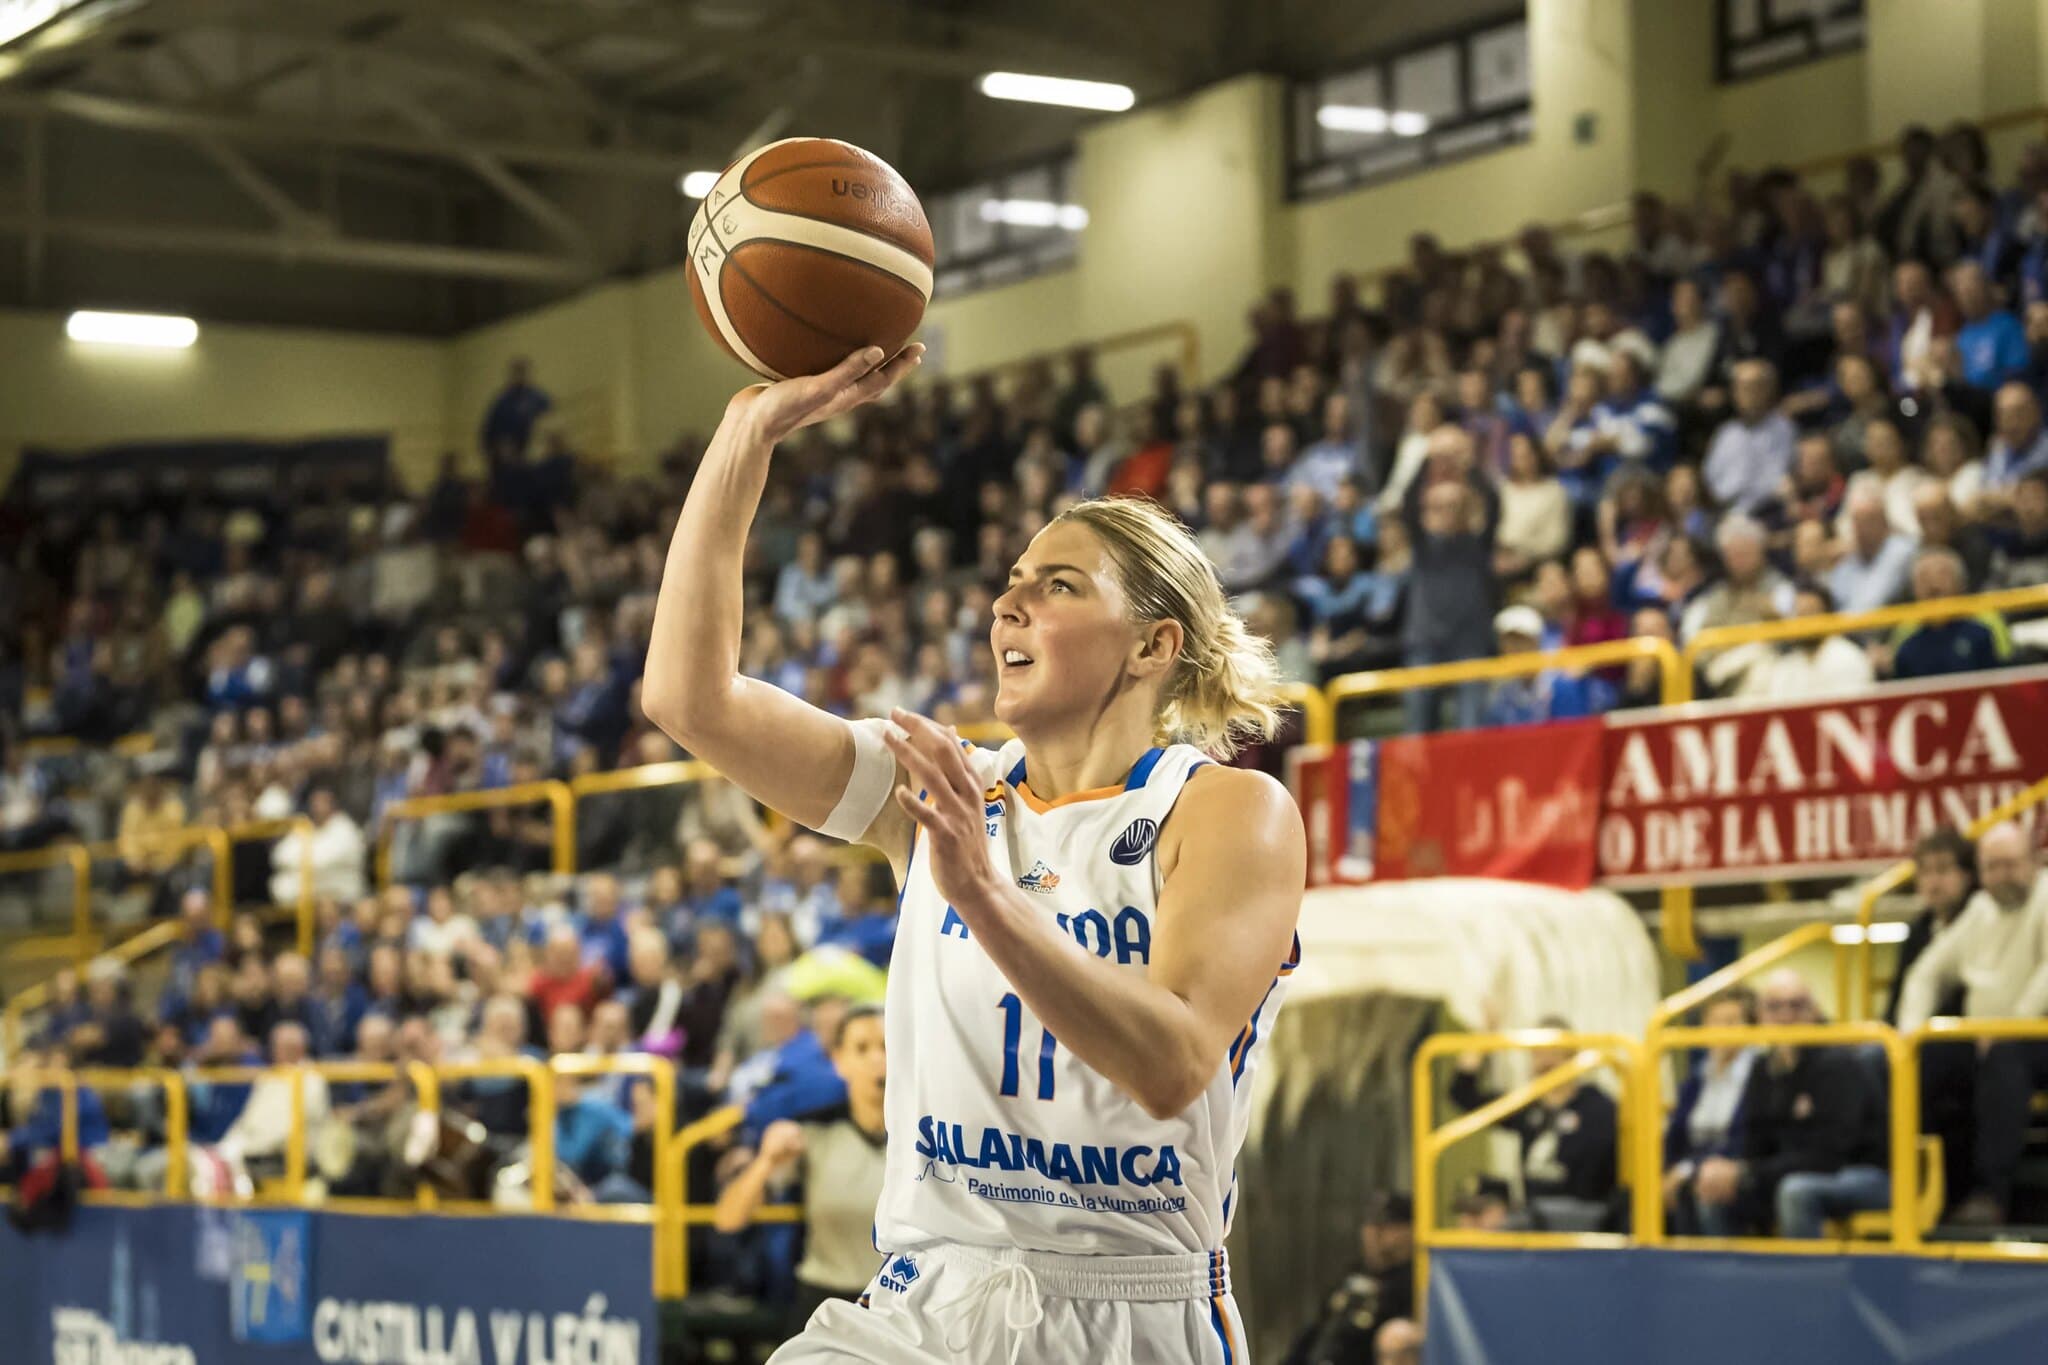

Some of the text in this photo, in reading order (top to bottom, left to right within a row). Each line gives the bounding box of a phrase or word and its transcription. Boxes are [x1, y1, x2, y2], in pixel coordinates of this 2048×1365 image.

[1645, 806, 1711, 869] DE
[1721, 803, 1781, 864] LA
[996, 992, 1057, 1102] 11
[915, 1115, 1183, 1187] SALAMANCA
[968, 1178, 1055, 1204] Patrimonio
[1081, 1194, 1096, 1210] la
